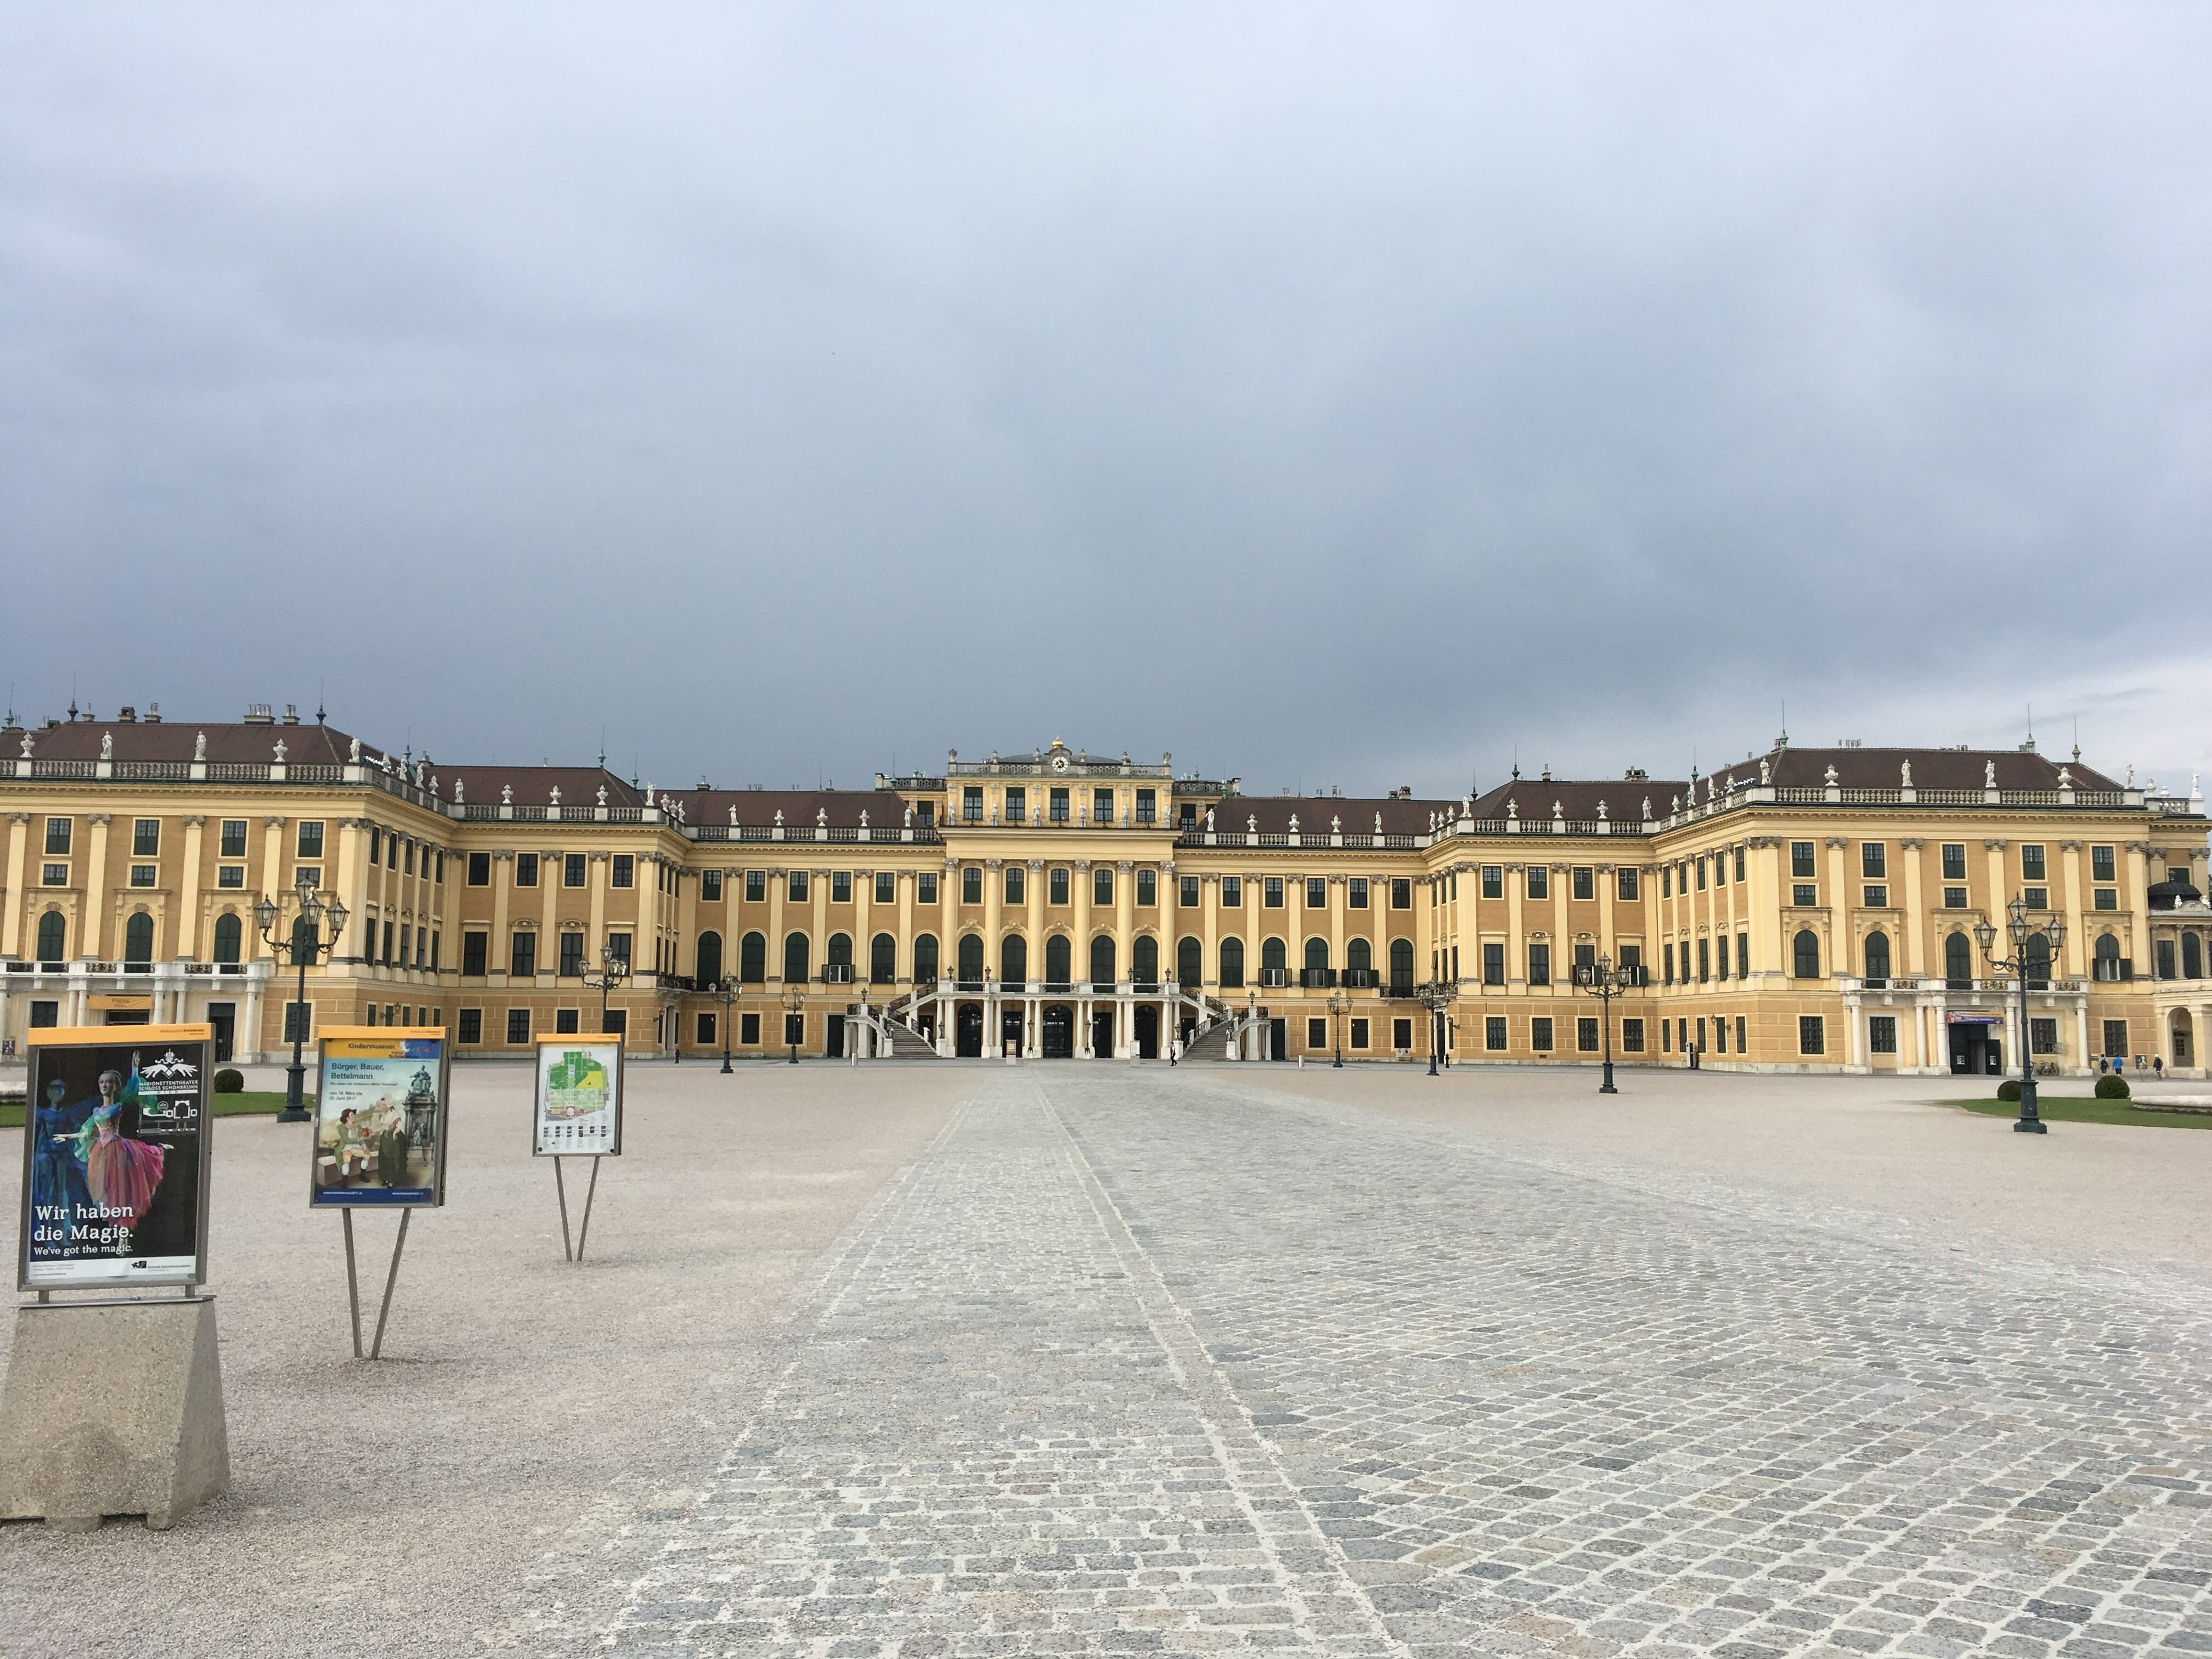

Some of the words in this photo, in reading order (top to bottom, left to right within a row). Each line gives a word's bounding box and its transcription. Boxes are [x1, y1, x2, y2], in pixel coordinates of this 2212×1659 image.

[331, 1063, 358, 1071] Bürger,
[35, 1205, 69, 1220] Wir
[76, 1203, 133, 1219] haben
[34, 1225, 63, 1241] die
[70, 1224, 133, 1243] Magie.
[34, 1246, 61, 1255] We've
[64, 1246, 79, 1256] got
[82, 1244, 98, 1254] the
[101, 1244, 133, 1255] magic.
